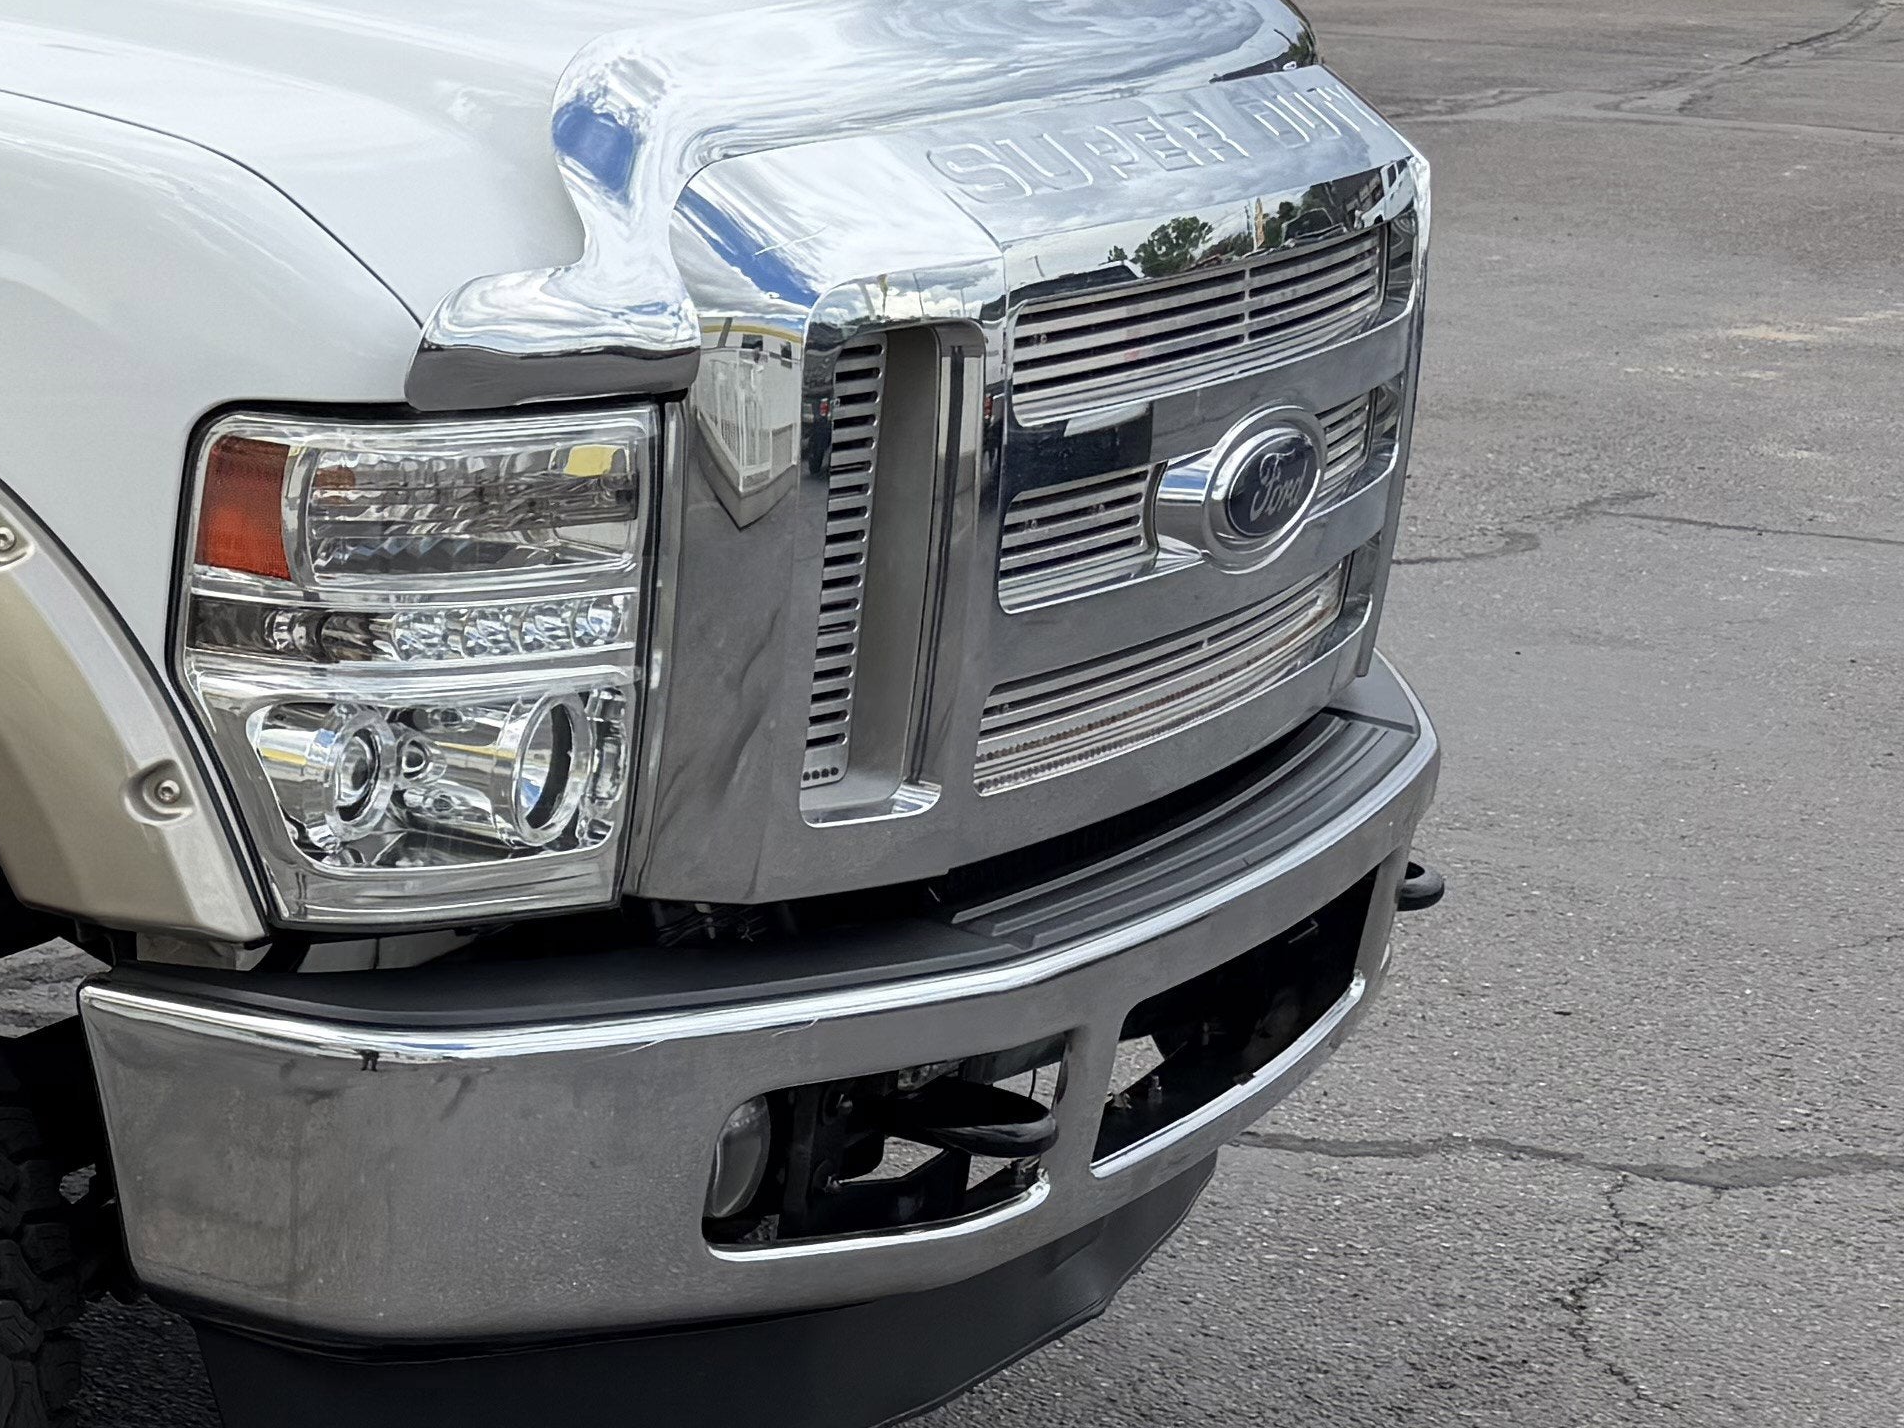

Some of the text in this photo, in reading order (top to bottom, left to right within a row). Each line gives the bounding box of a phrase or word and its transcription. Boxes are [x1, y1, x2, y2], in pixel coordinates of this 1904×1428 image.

[927, 84, 1380, 205] SUPER DUTY
[1249, 448, 1309, 522] Ford
